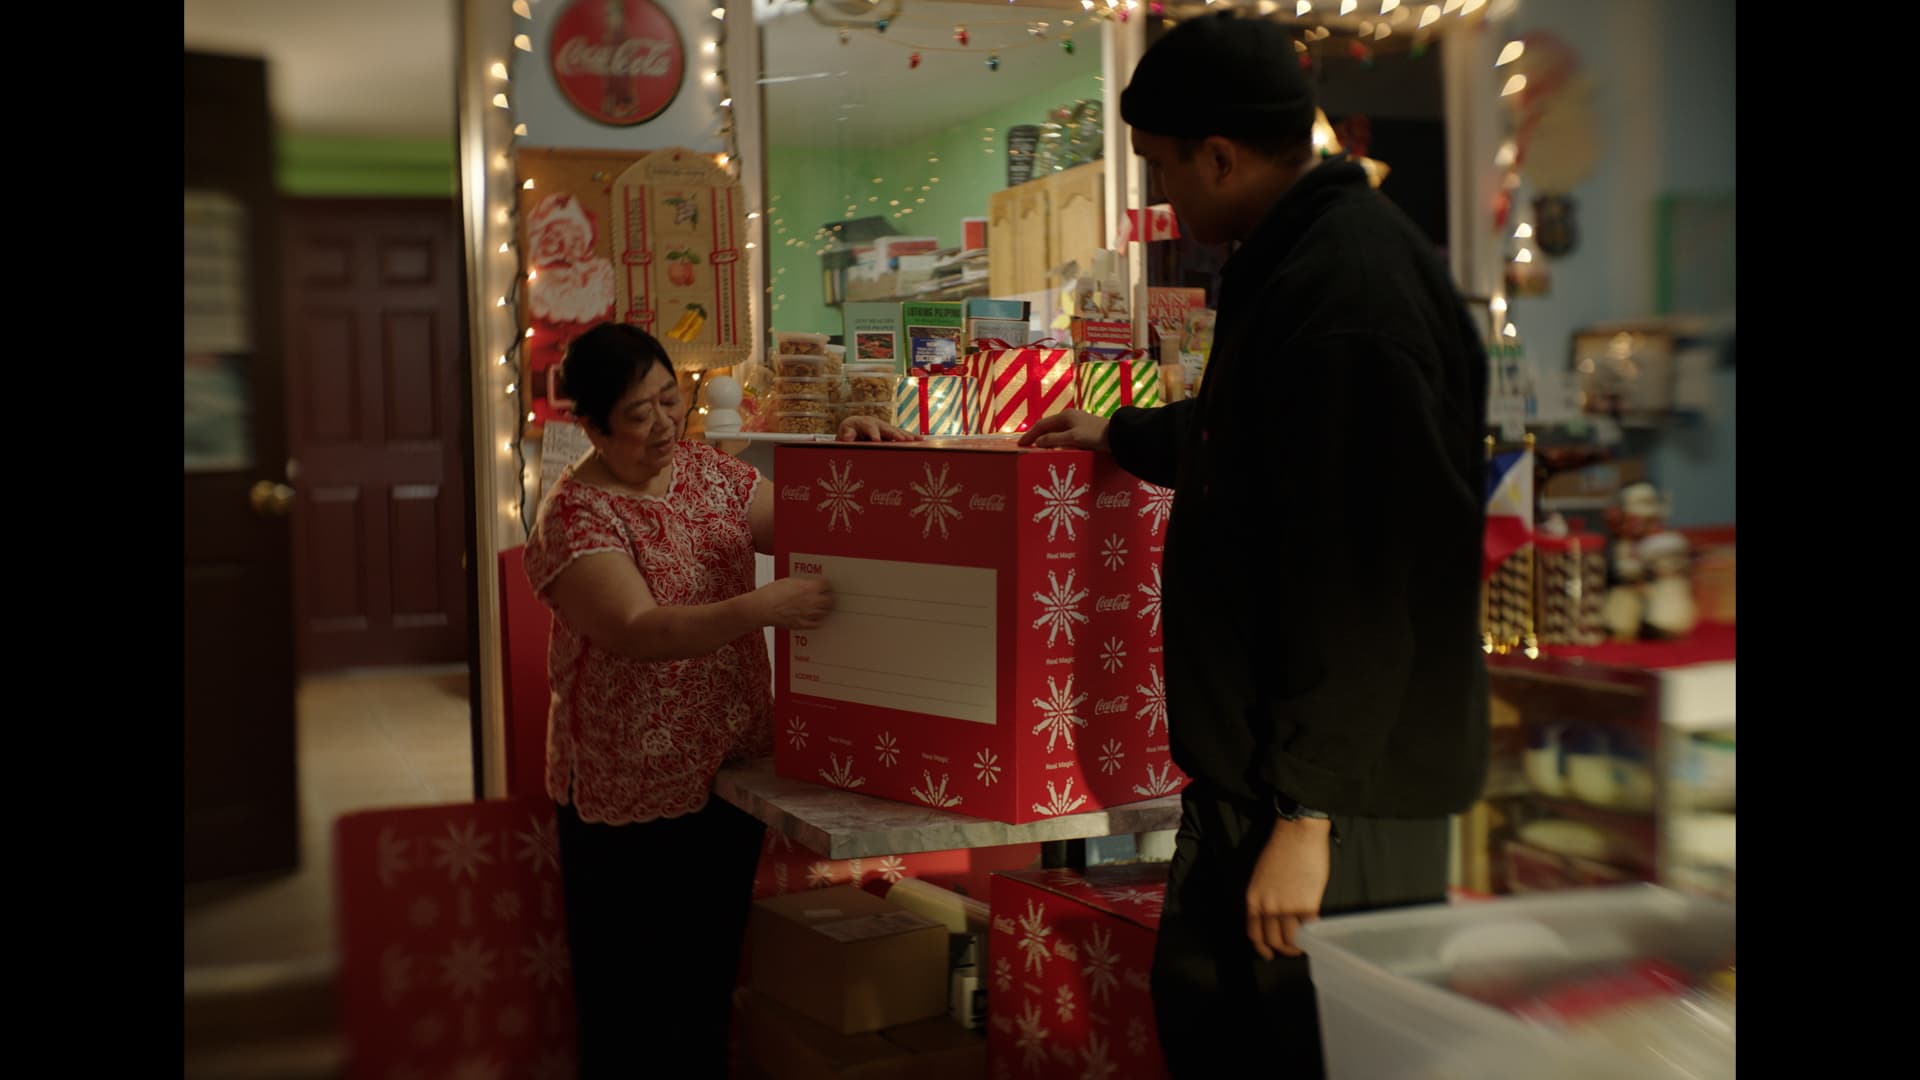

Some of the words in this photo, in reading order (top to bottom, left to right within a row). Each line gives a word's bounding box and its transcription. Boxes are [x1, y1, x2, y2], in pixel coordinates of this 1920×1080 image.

[781, 483, 811, 502] Coca-Cola
[869, 488, 904, 507] Coca-Cola
[1096, 490, 1132, 509] Coca-Cola
[968, 493, 1008, 512] Coca-Cola
[1046, 552, 1059, 560] Real
[794, 561, 823, 575] FROM
[1095, 593, 1131, 612] Coca-Cola
[794, 635, 808, 647] TO
[1094, 695, 1130, 715] Coca-Cola
